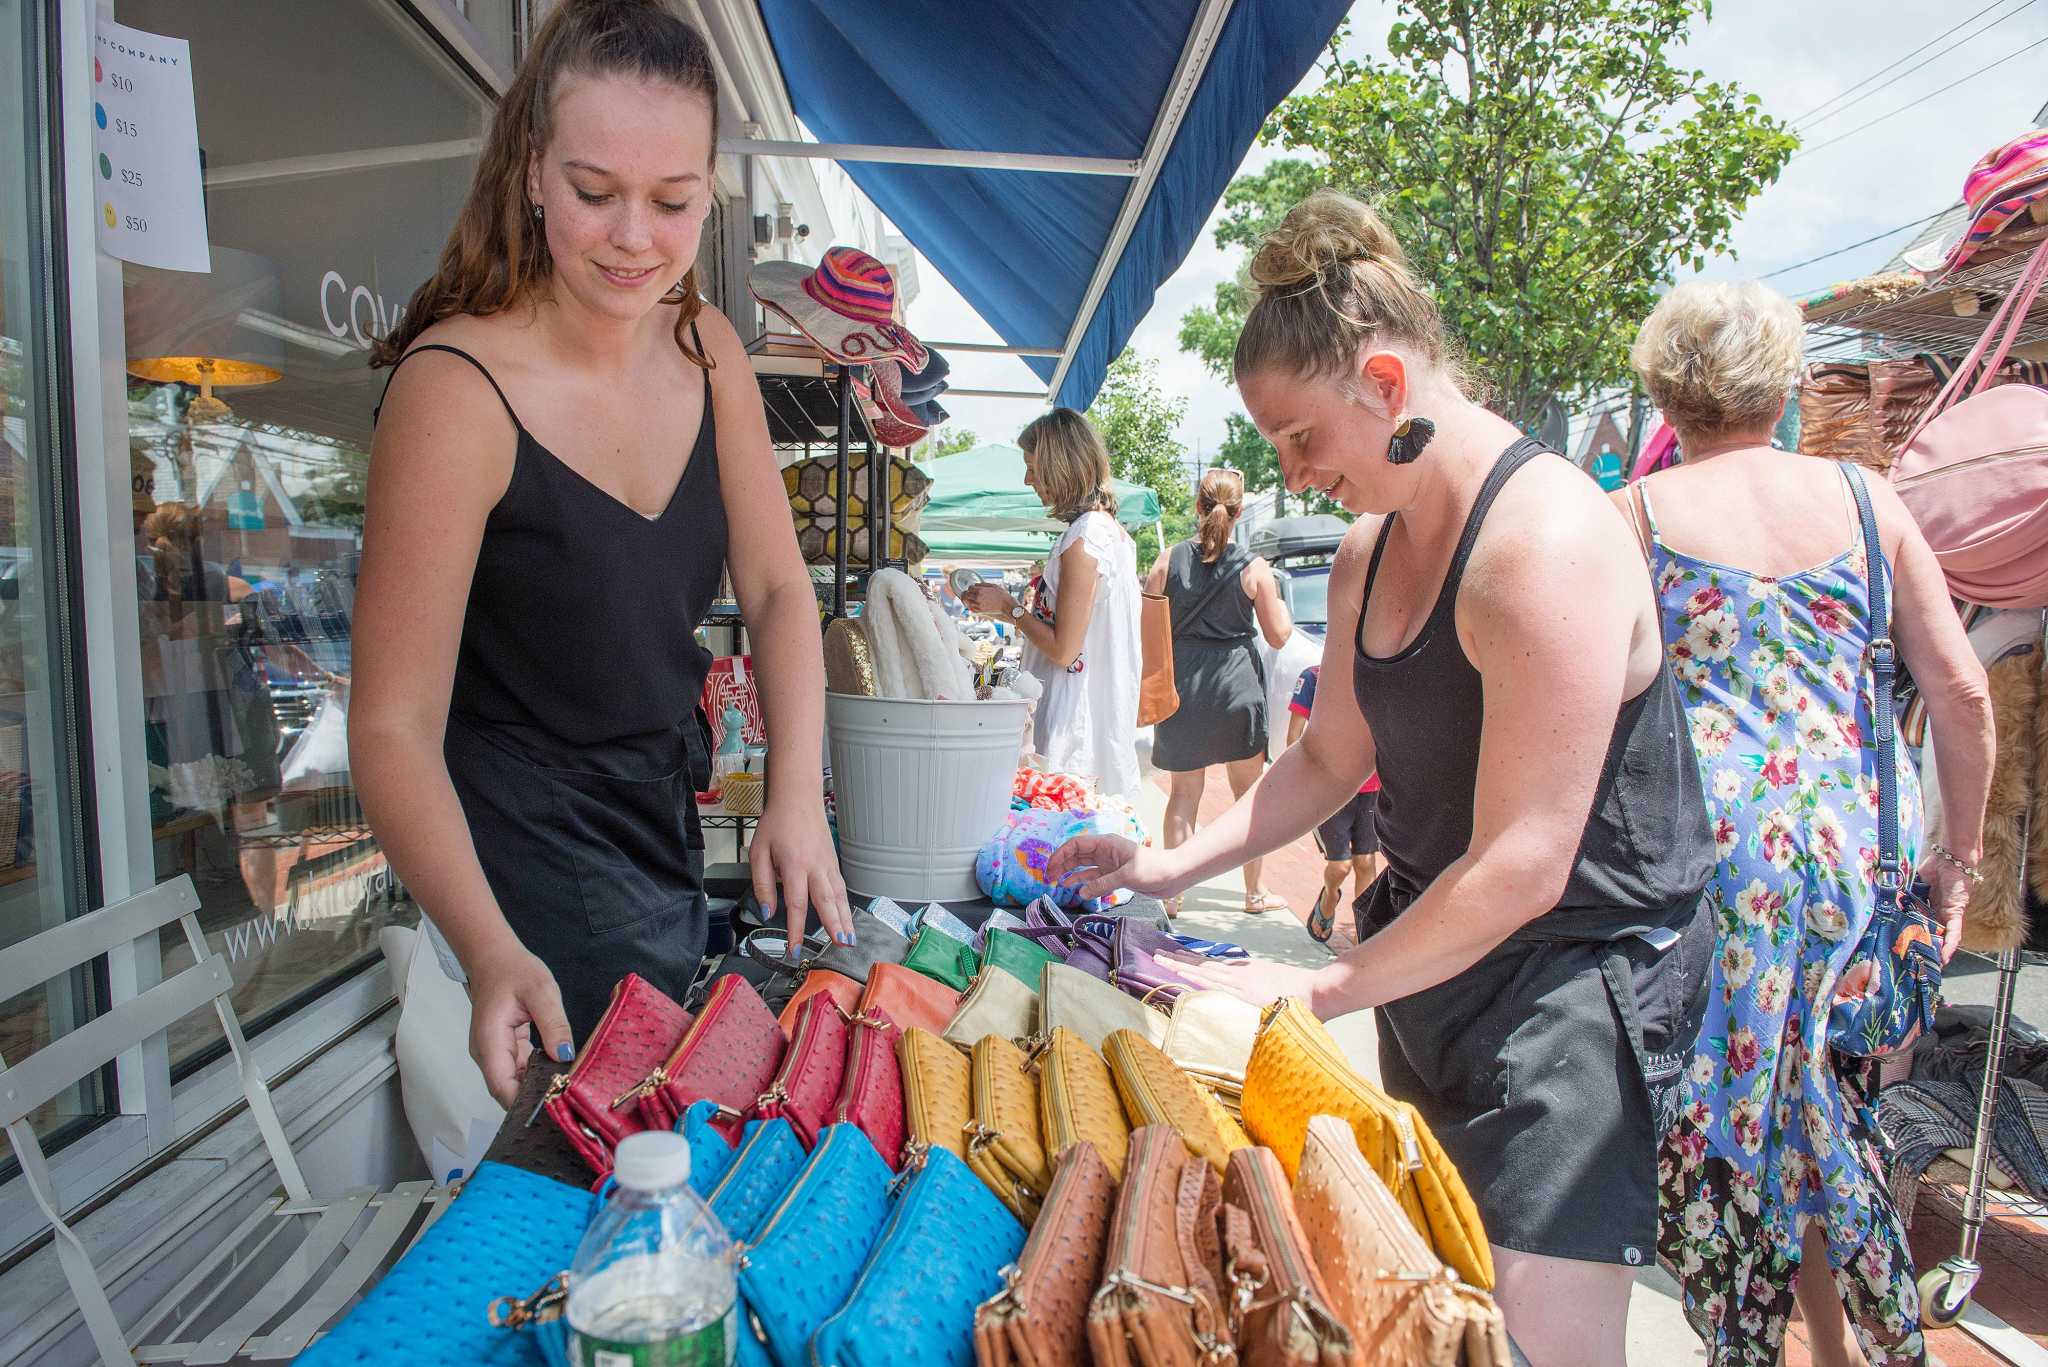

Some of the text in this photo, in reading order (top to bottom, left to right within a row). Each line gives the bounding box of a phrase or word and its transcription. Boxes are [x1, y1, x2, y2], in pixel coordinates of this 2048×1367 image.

[110, 41, 179, 66] COMPANY
[111, 72, 133, 93] $10
[115, 118, 138, 137] $15
[120, 168, 143, 187] $25
[125, 215, 148, 233] $50
